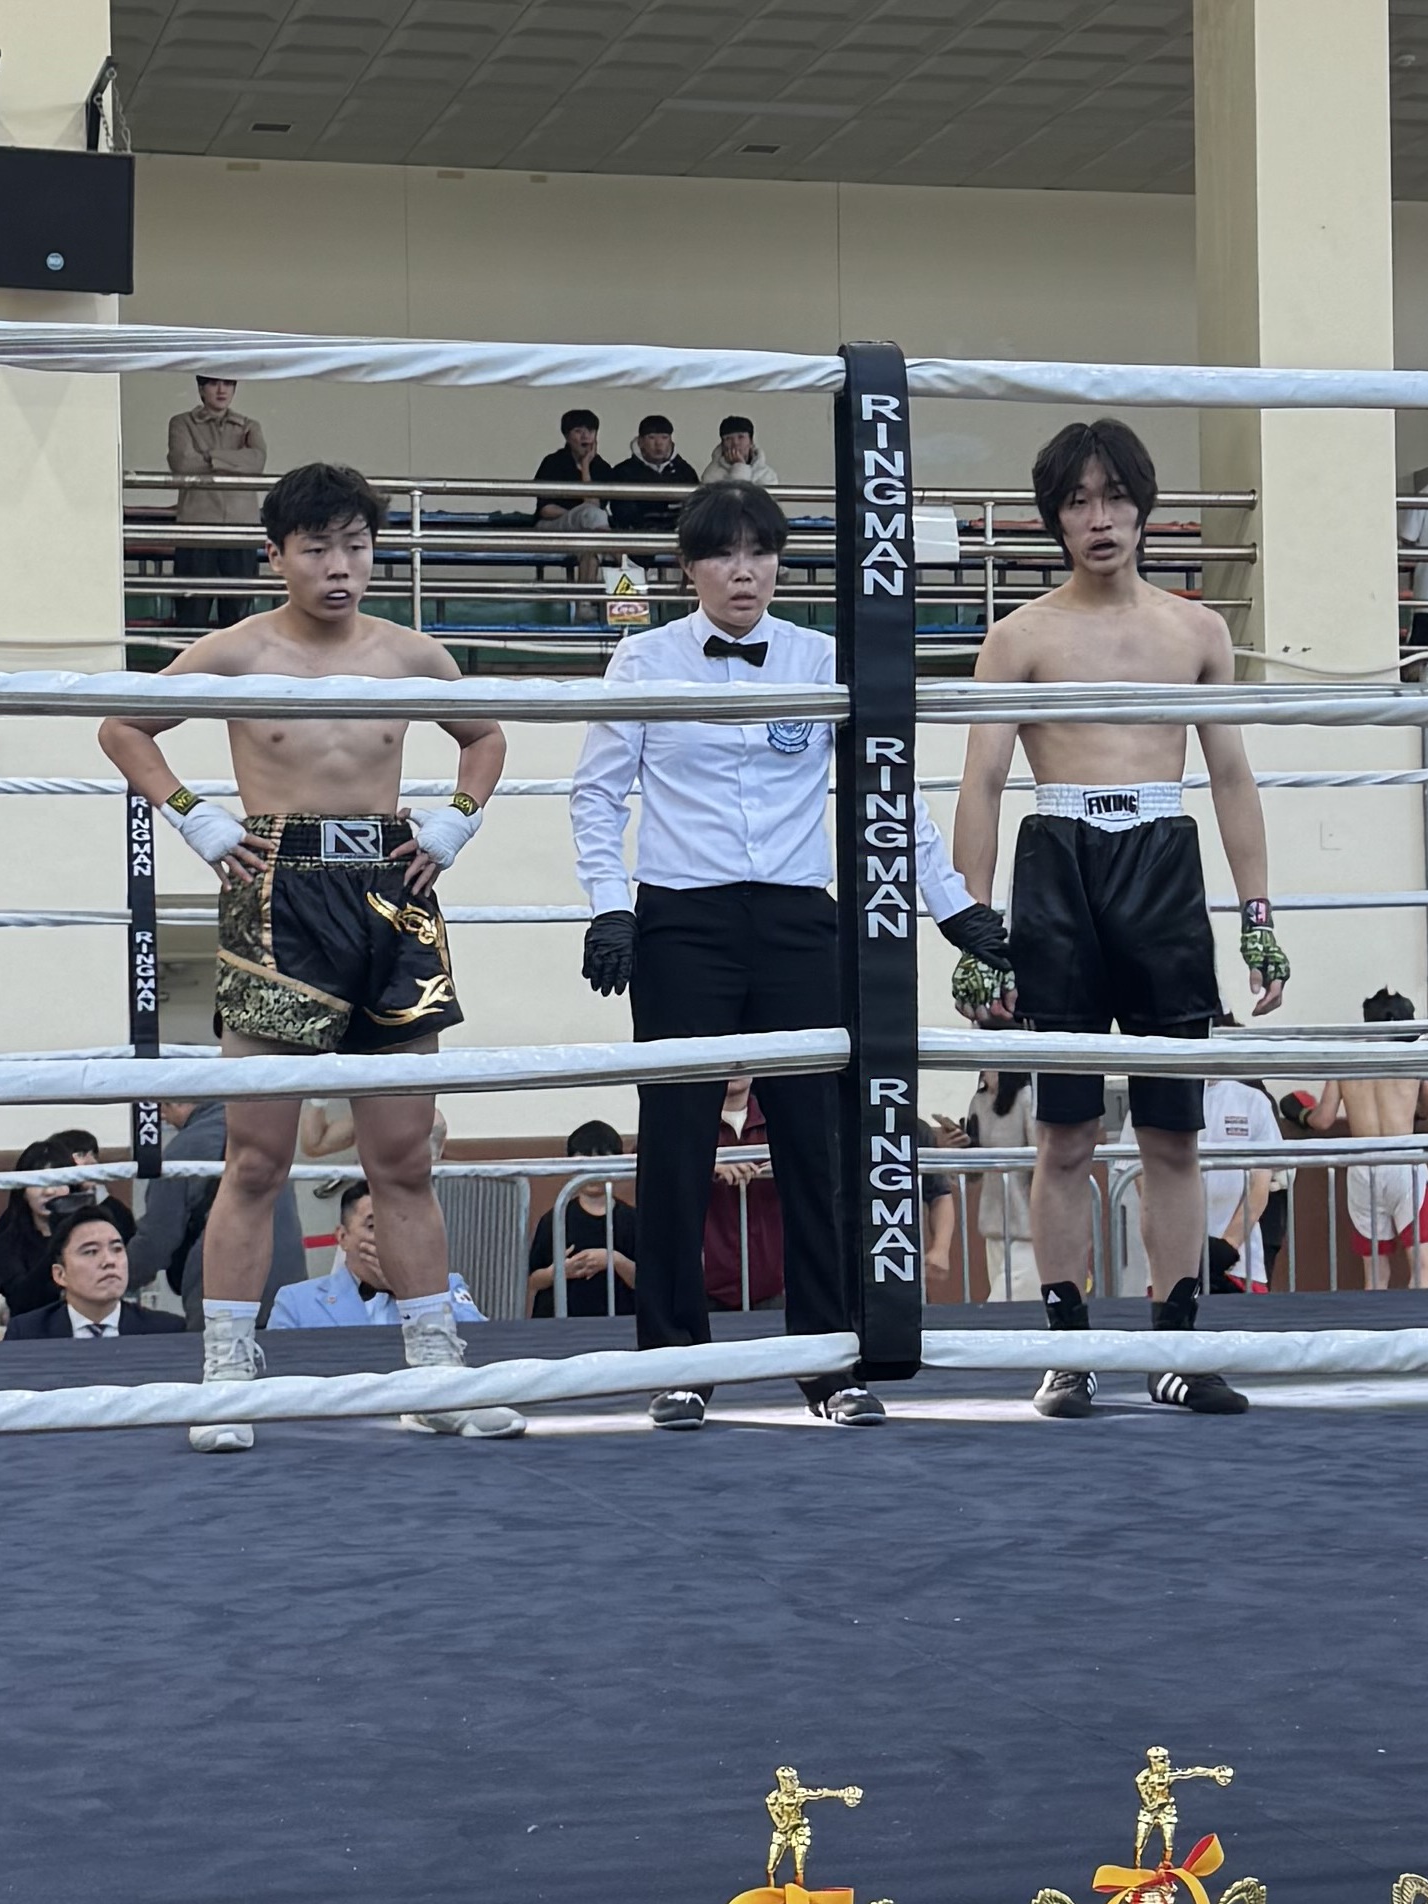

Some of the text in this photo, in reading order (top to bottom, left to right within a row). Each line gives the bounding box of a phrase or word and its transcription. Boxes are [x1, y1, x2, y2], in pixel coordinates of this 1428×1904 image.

[860, 394, 908, 596] RINGMAN
[131, 796, 152, 876] RINGMAN
[863, 737, 911, 938] RINGMAN
[135, 931, 156, 1013] RINGMAN
[869, 1078, 918, 1283] RINGMAN
